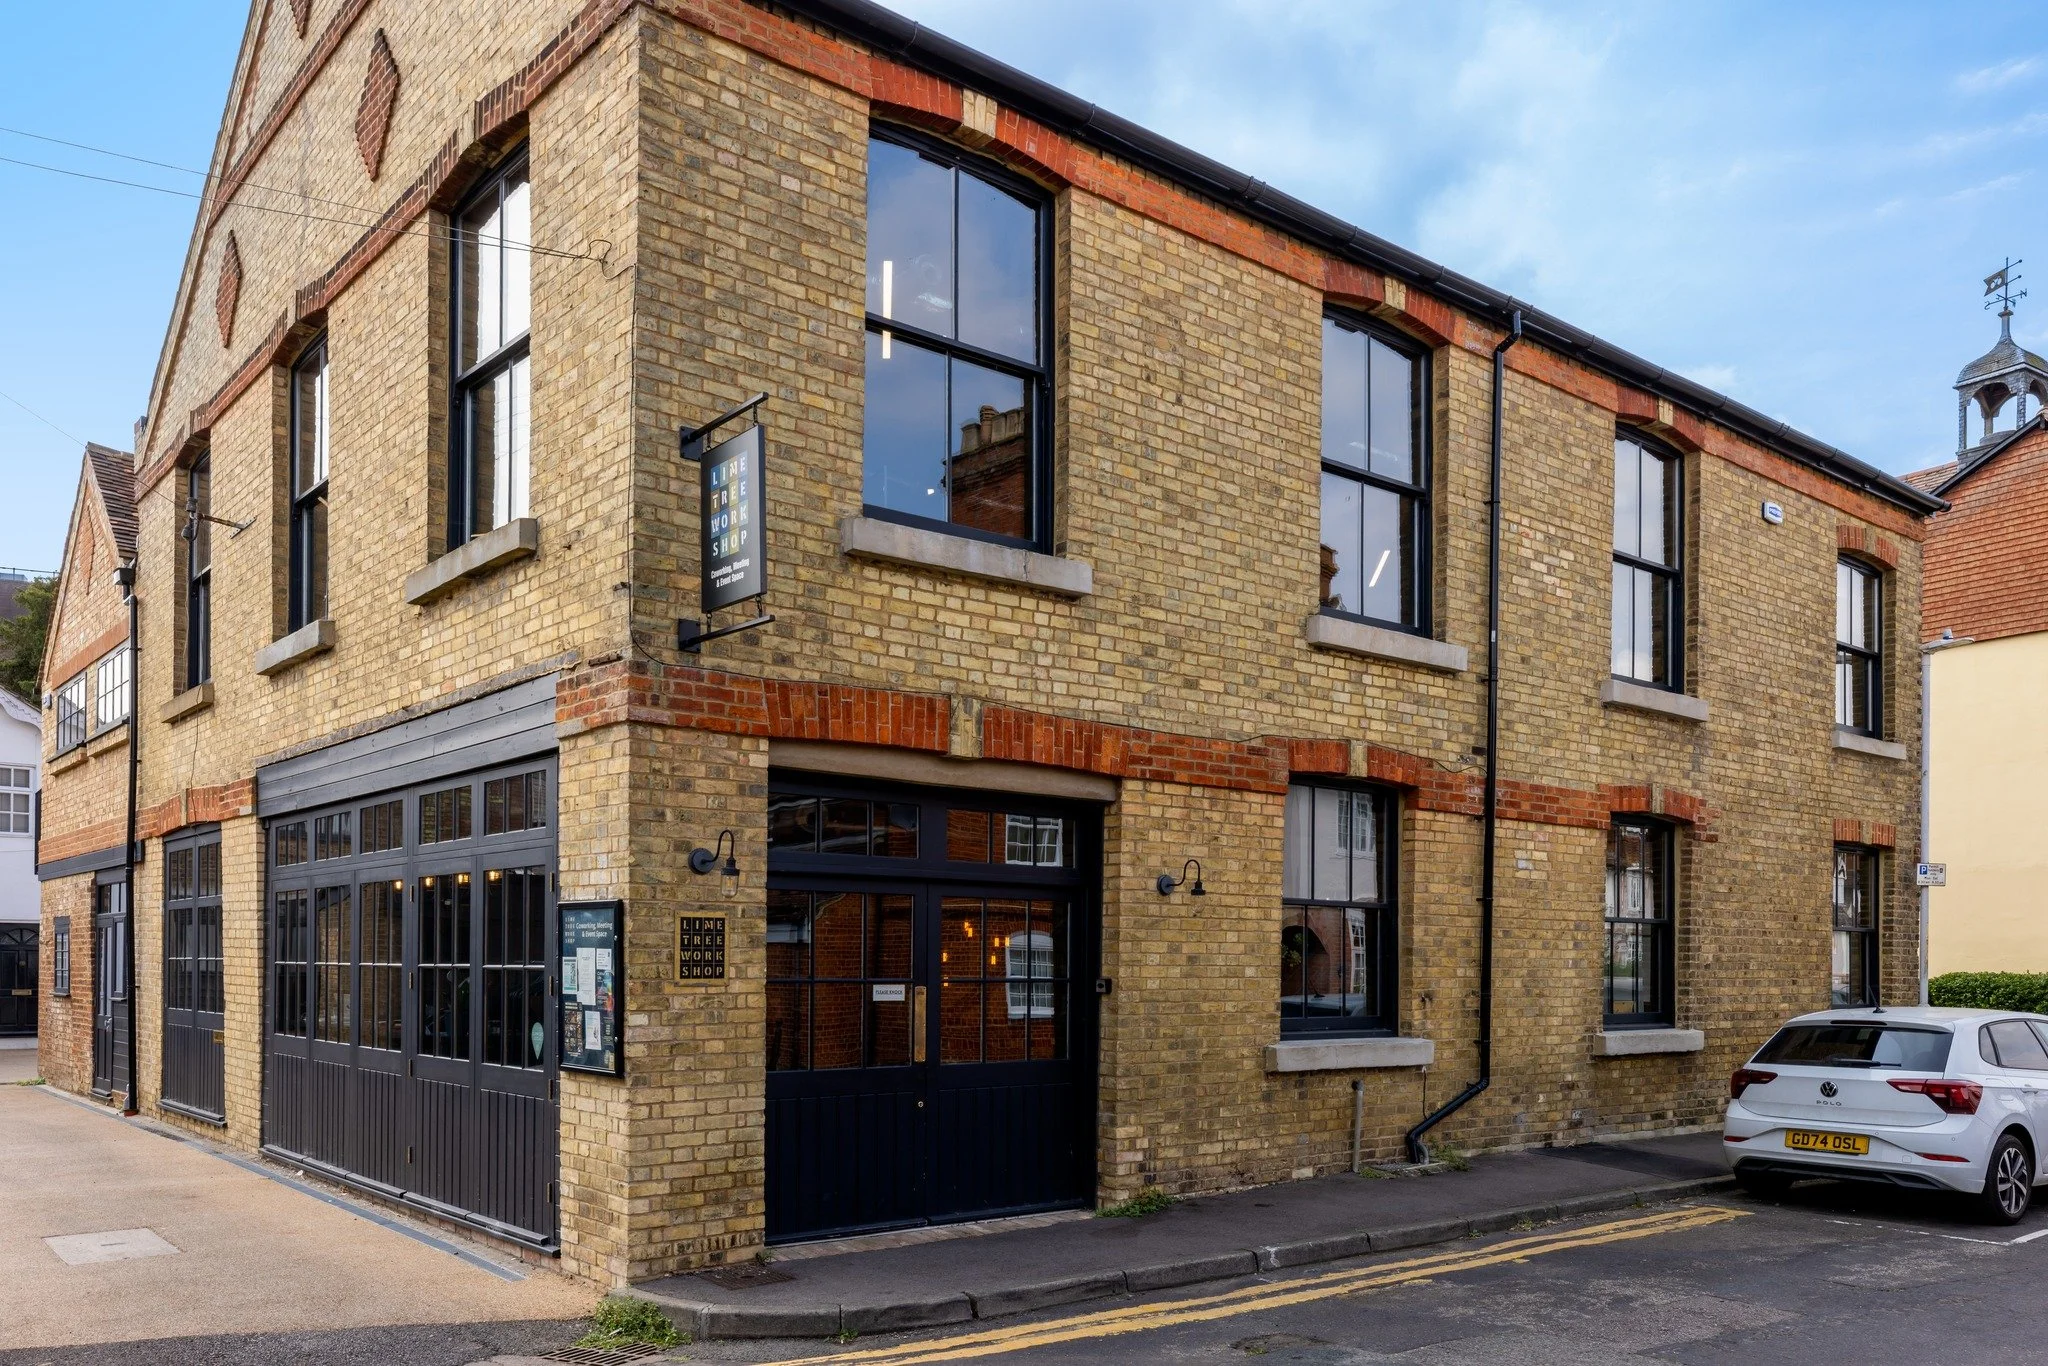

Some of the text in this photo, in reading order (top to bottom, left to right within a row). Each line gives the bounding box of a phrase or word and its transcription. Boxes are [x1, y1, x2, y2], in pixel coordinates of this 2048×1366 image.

[712, 456, 746, 486] LIME
[712, 481, 746, 509] TREE
[711, 504, 747, 533] WORK
[712, 529, 747, 557] SHOP
[720, 575, 731, 587] Event
[732, 571, 744, 582] Space
[683, 920, 723, 930] LIME
[682, 935, 723, 945] TREE
[681, 951, 723, 960] WORK
[682, 966, 723, 976] SHOP
[1792, 1132, 1861, 1151] GD74 OSL
